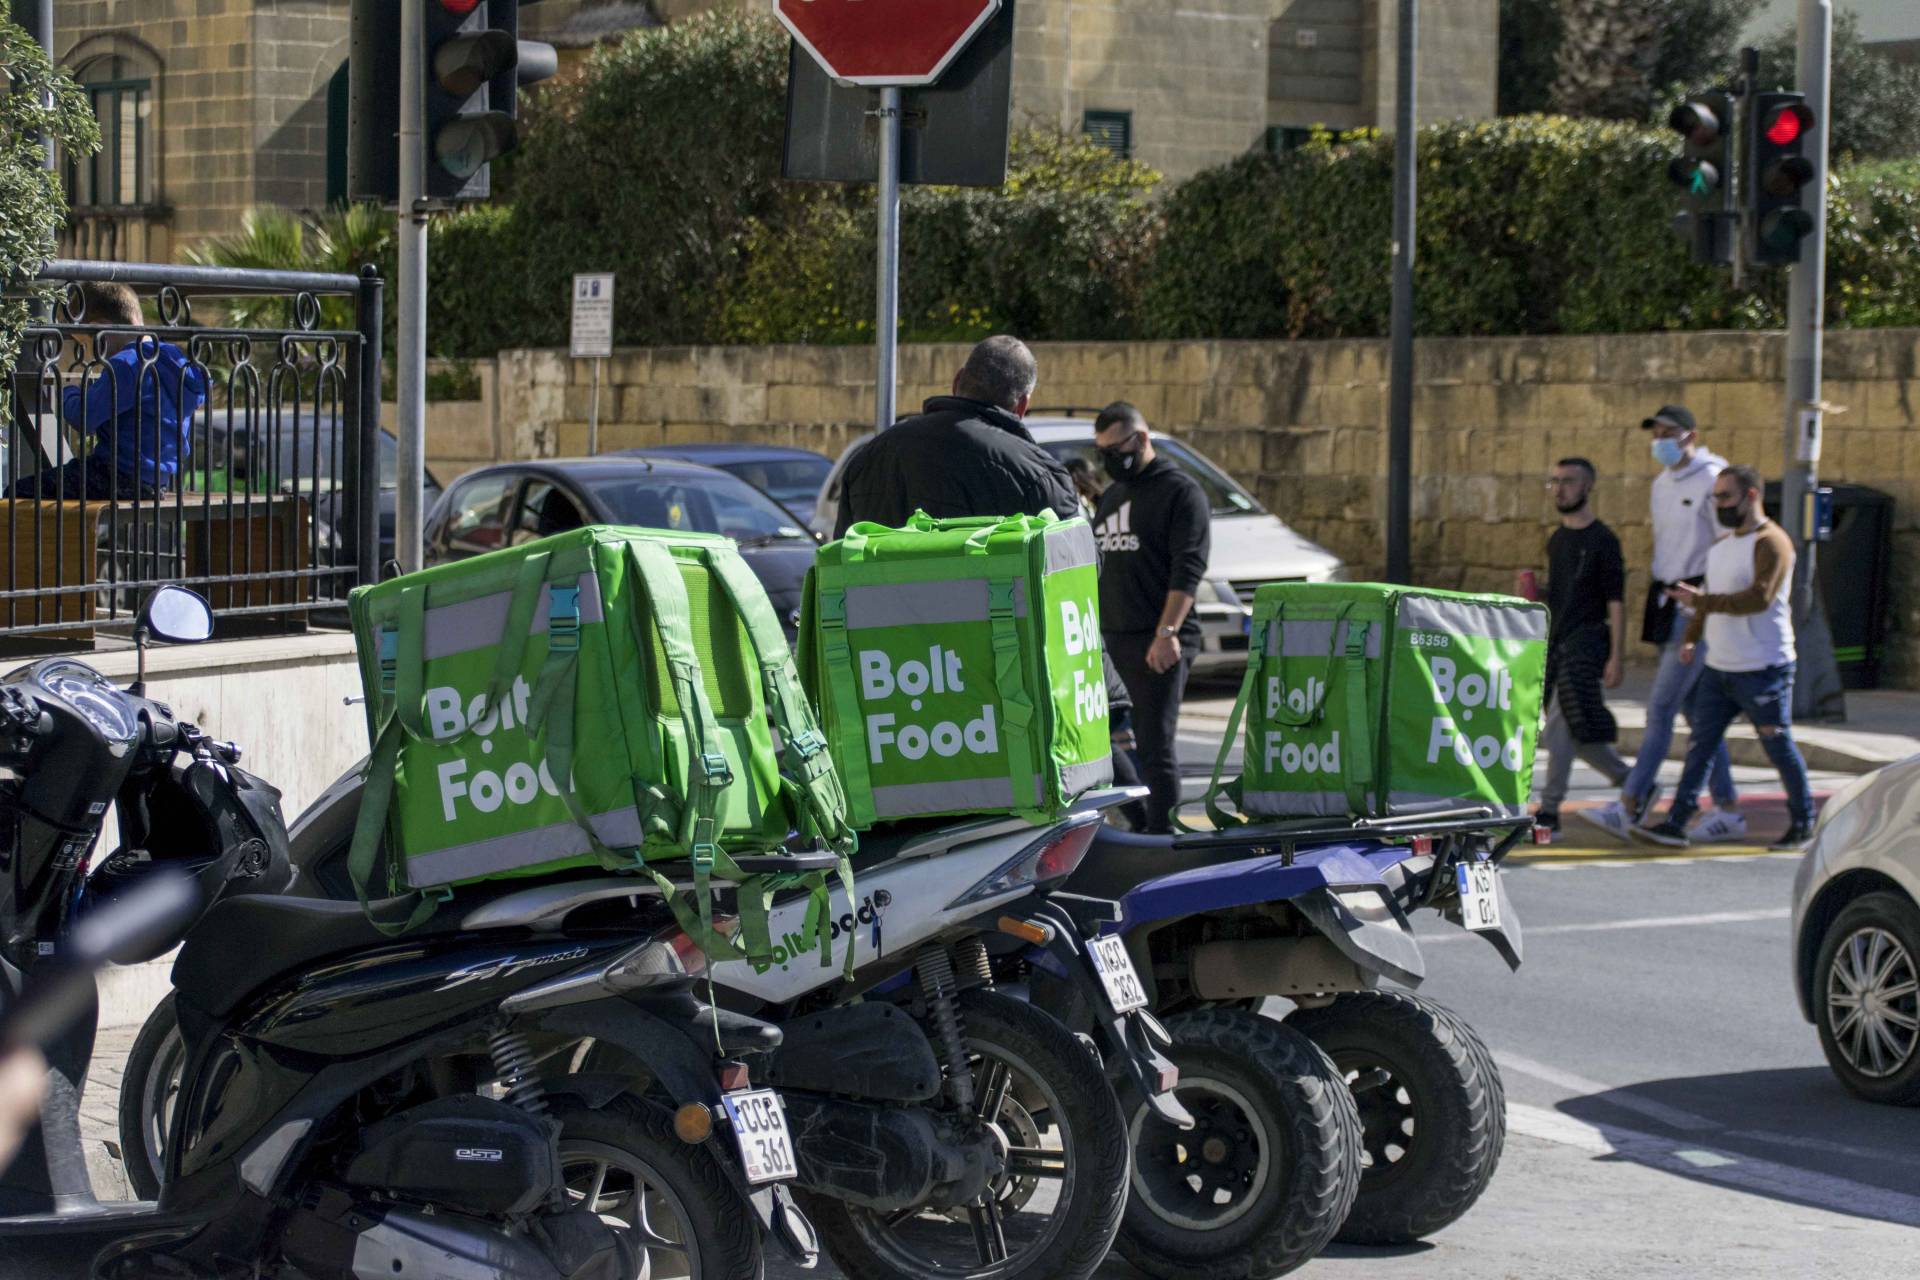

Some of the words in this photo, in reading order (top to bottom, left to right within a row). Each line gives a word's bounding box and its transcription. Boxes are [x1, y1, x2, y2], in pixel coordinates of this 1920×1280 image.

[1060, 597, 1101, 656] Bol
[1410, 633, 1449, 648] B6358
[859, 644, 965, 700] Bolt
[1431, 656, 1513, 711] Bolt
[866, 704, 999, 764] Food
[1265, 731, 1341, 773] Food
[1427, 725, 1525, 772] Food
[740, 1097, 782, 1133] CCG
[756, 1137, 793, 1173] 361
